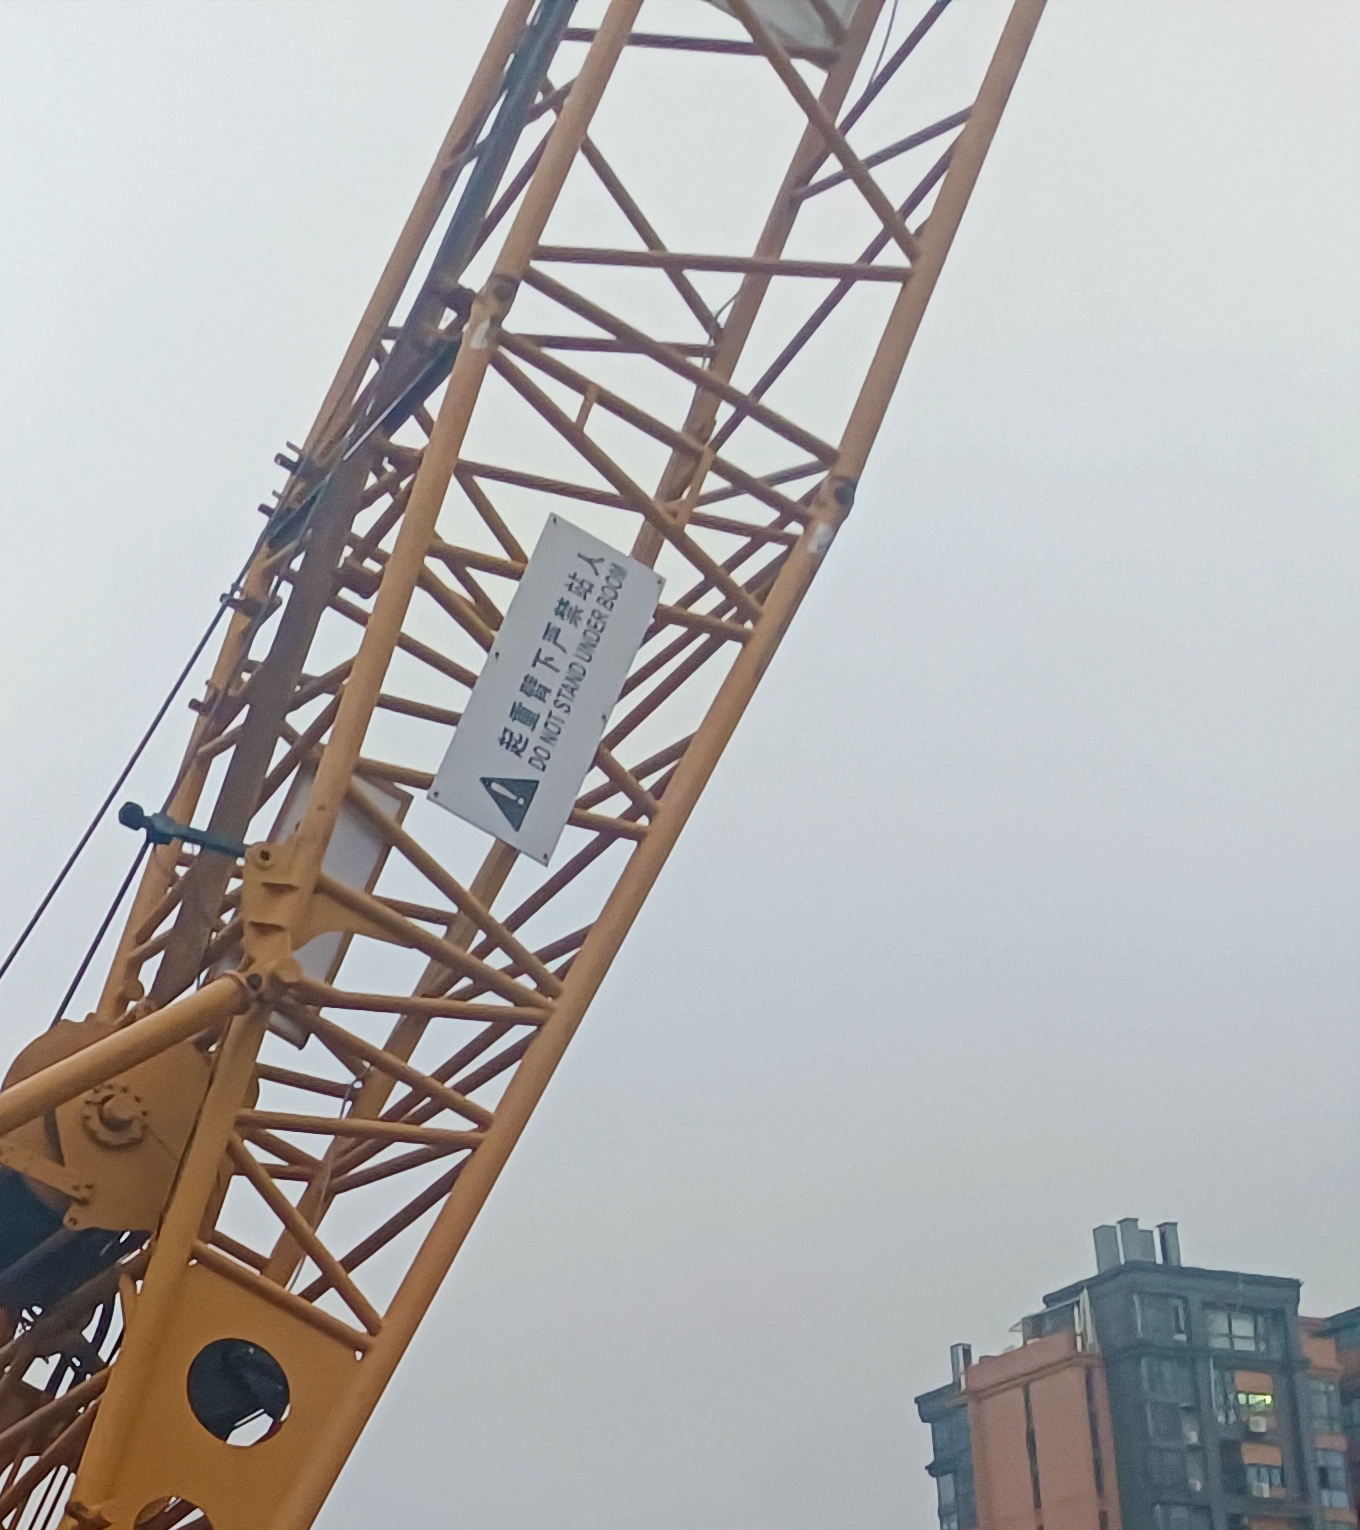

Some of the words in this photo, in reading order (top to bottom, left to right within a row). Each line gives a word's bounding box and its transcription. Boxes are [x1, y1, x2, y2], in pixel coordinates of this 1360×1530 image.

[595, 562, 629, 612] BOOM
[498, 552, 605, 759] 起重臂下严禁站人
[576, 610, 607, 664] UNDER
[554, 661, 586, 715] STAND
[539, 711, 566, 747] NOT
[528, 744, 552, 773] DO
